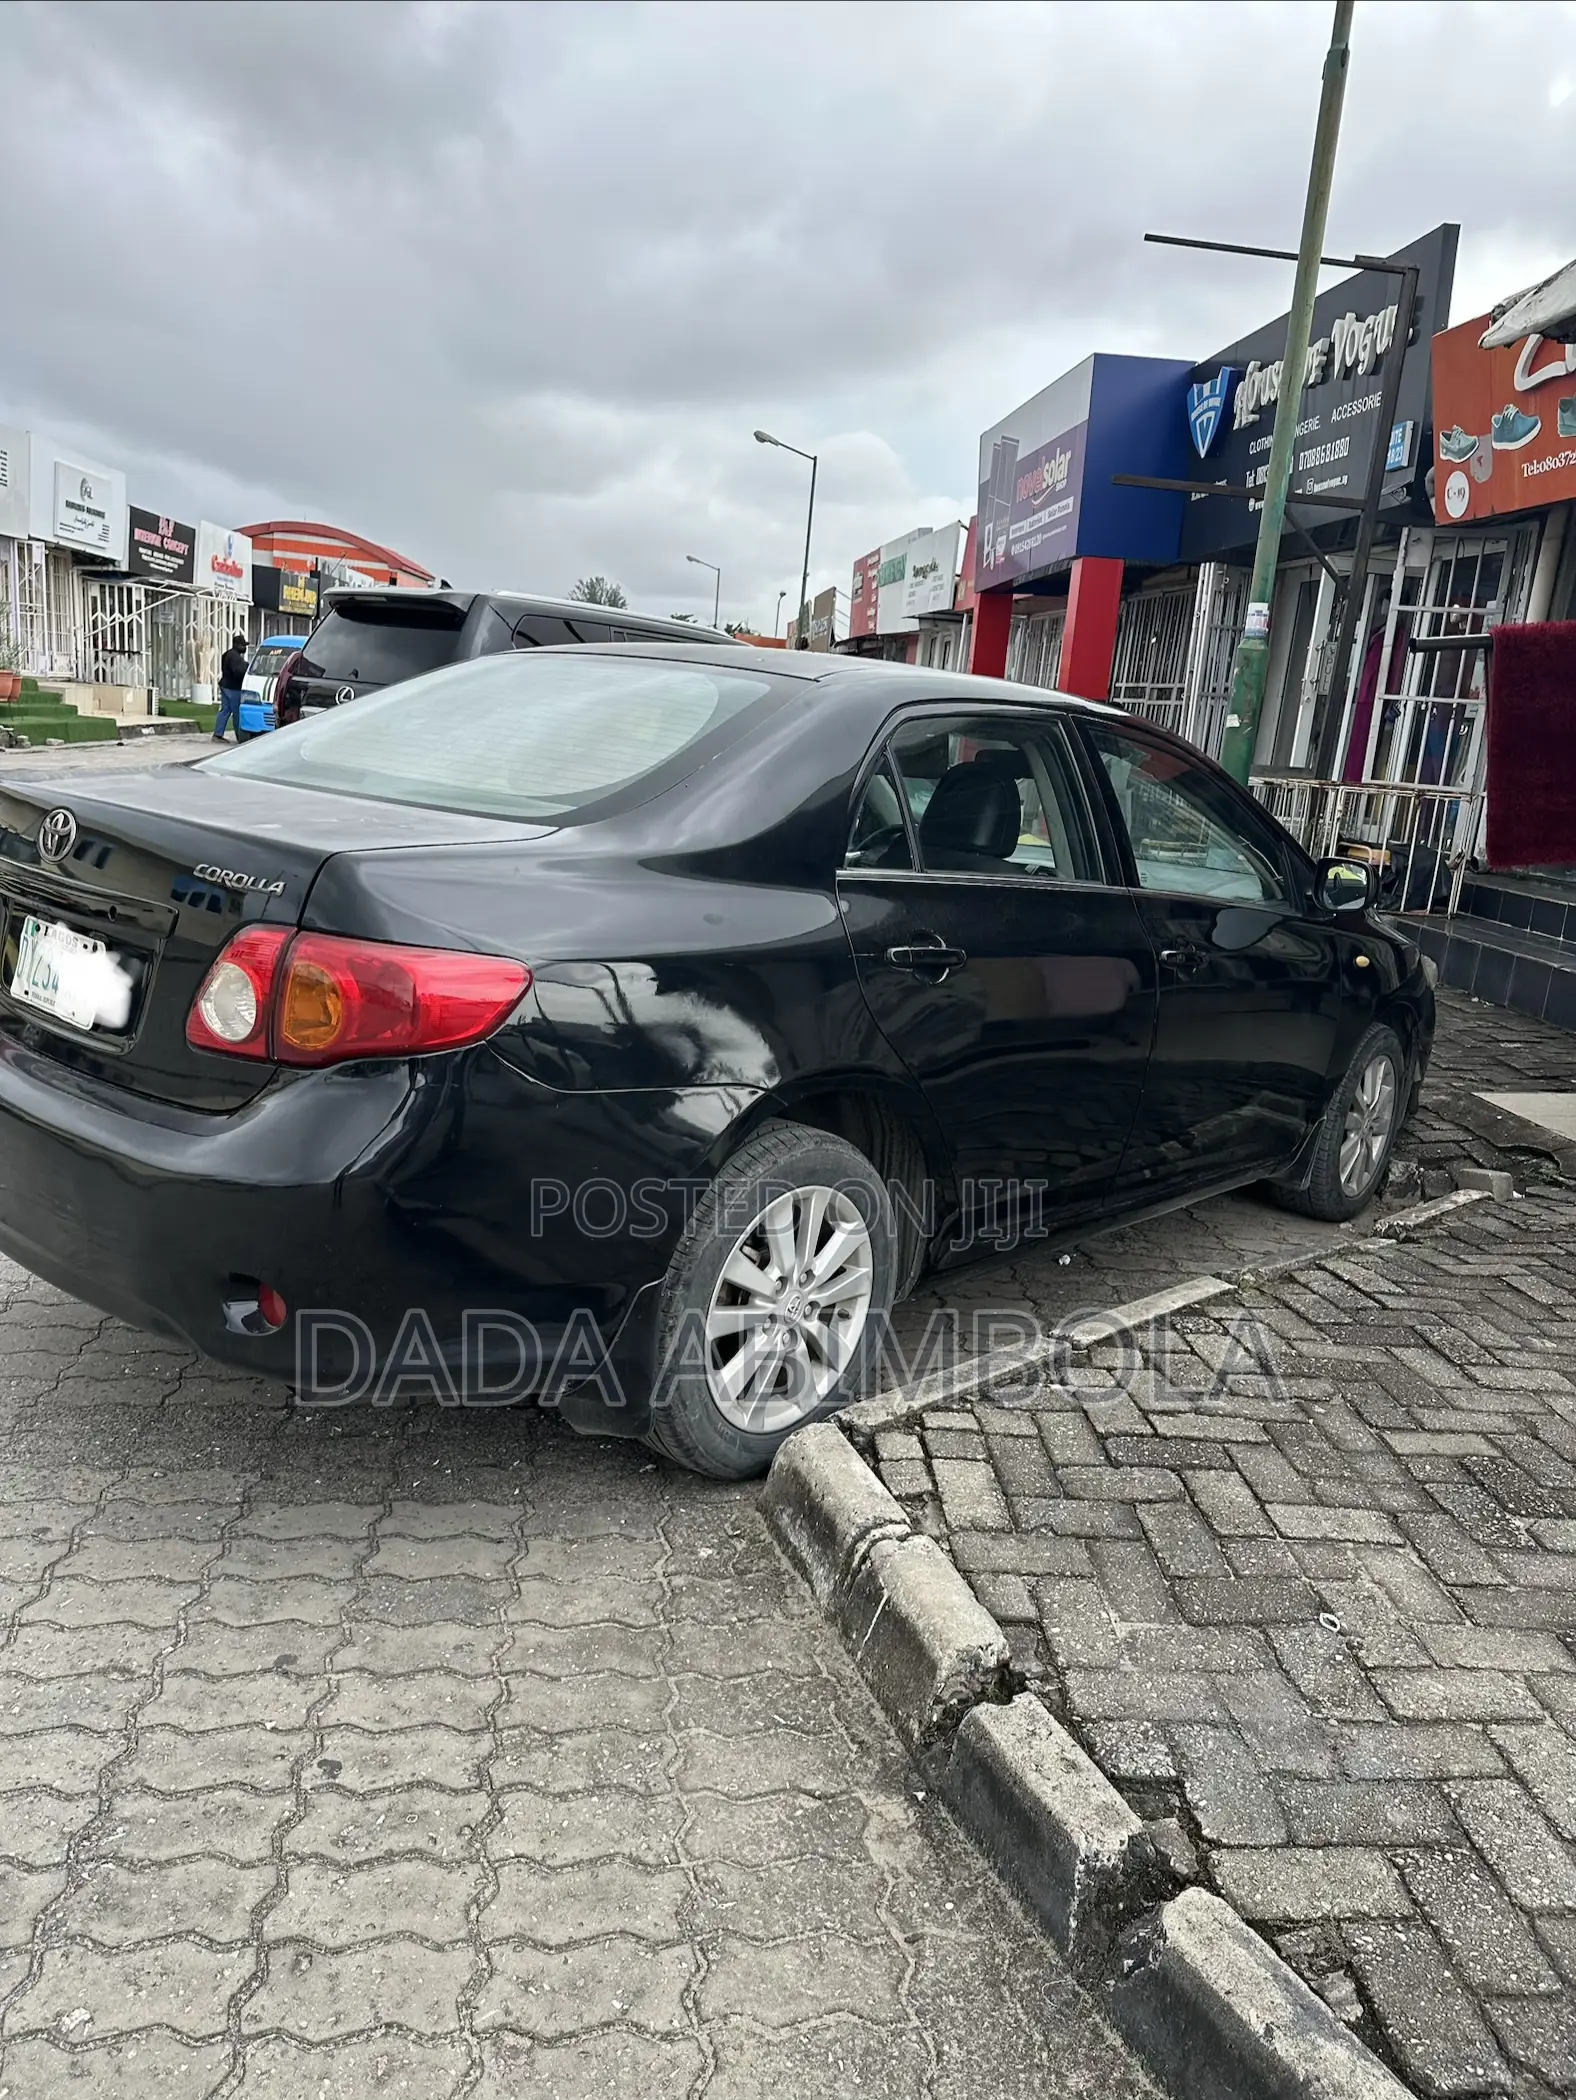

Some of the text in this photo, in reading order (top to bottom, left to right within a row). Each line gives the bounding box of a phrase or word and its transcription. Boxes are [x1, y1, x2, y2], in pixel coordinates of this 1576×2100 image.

[1249, 434, 1273, 455] CLOTHIN
[1331, 391, 1382, 423] ACCESSORIE
[1521, 449, 1576, 478] Tel:080372
[193, 863, 286, 896] COROLLA
